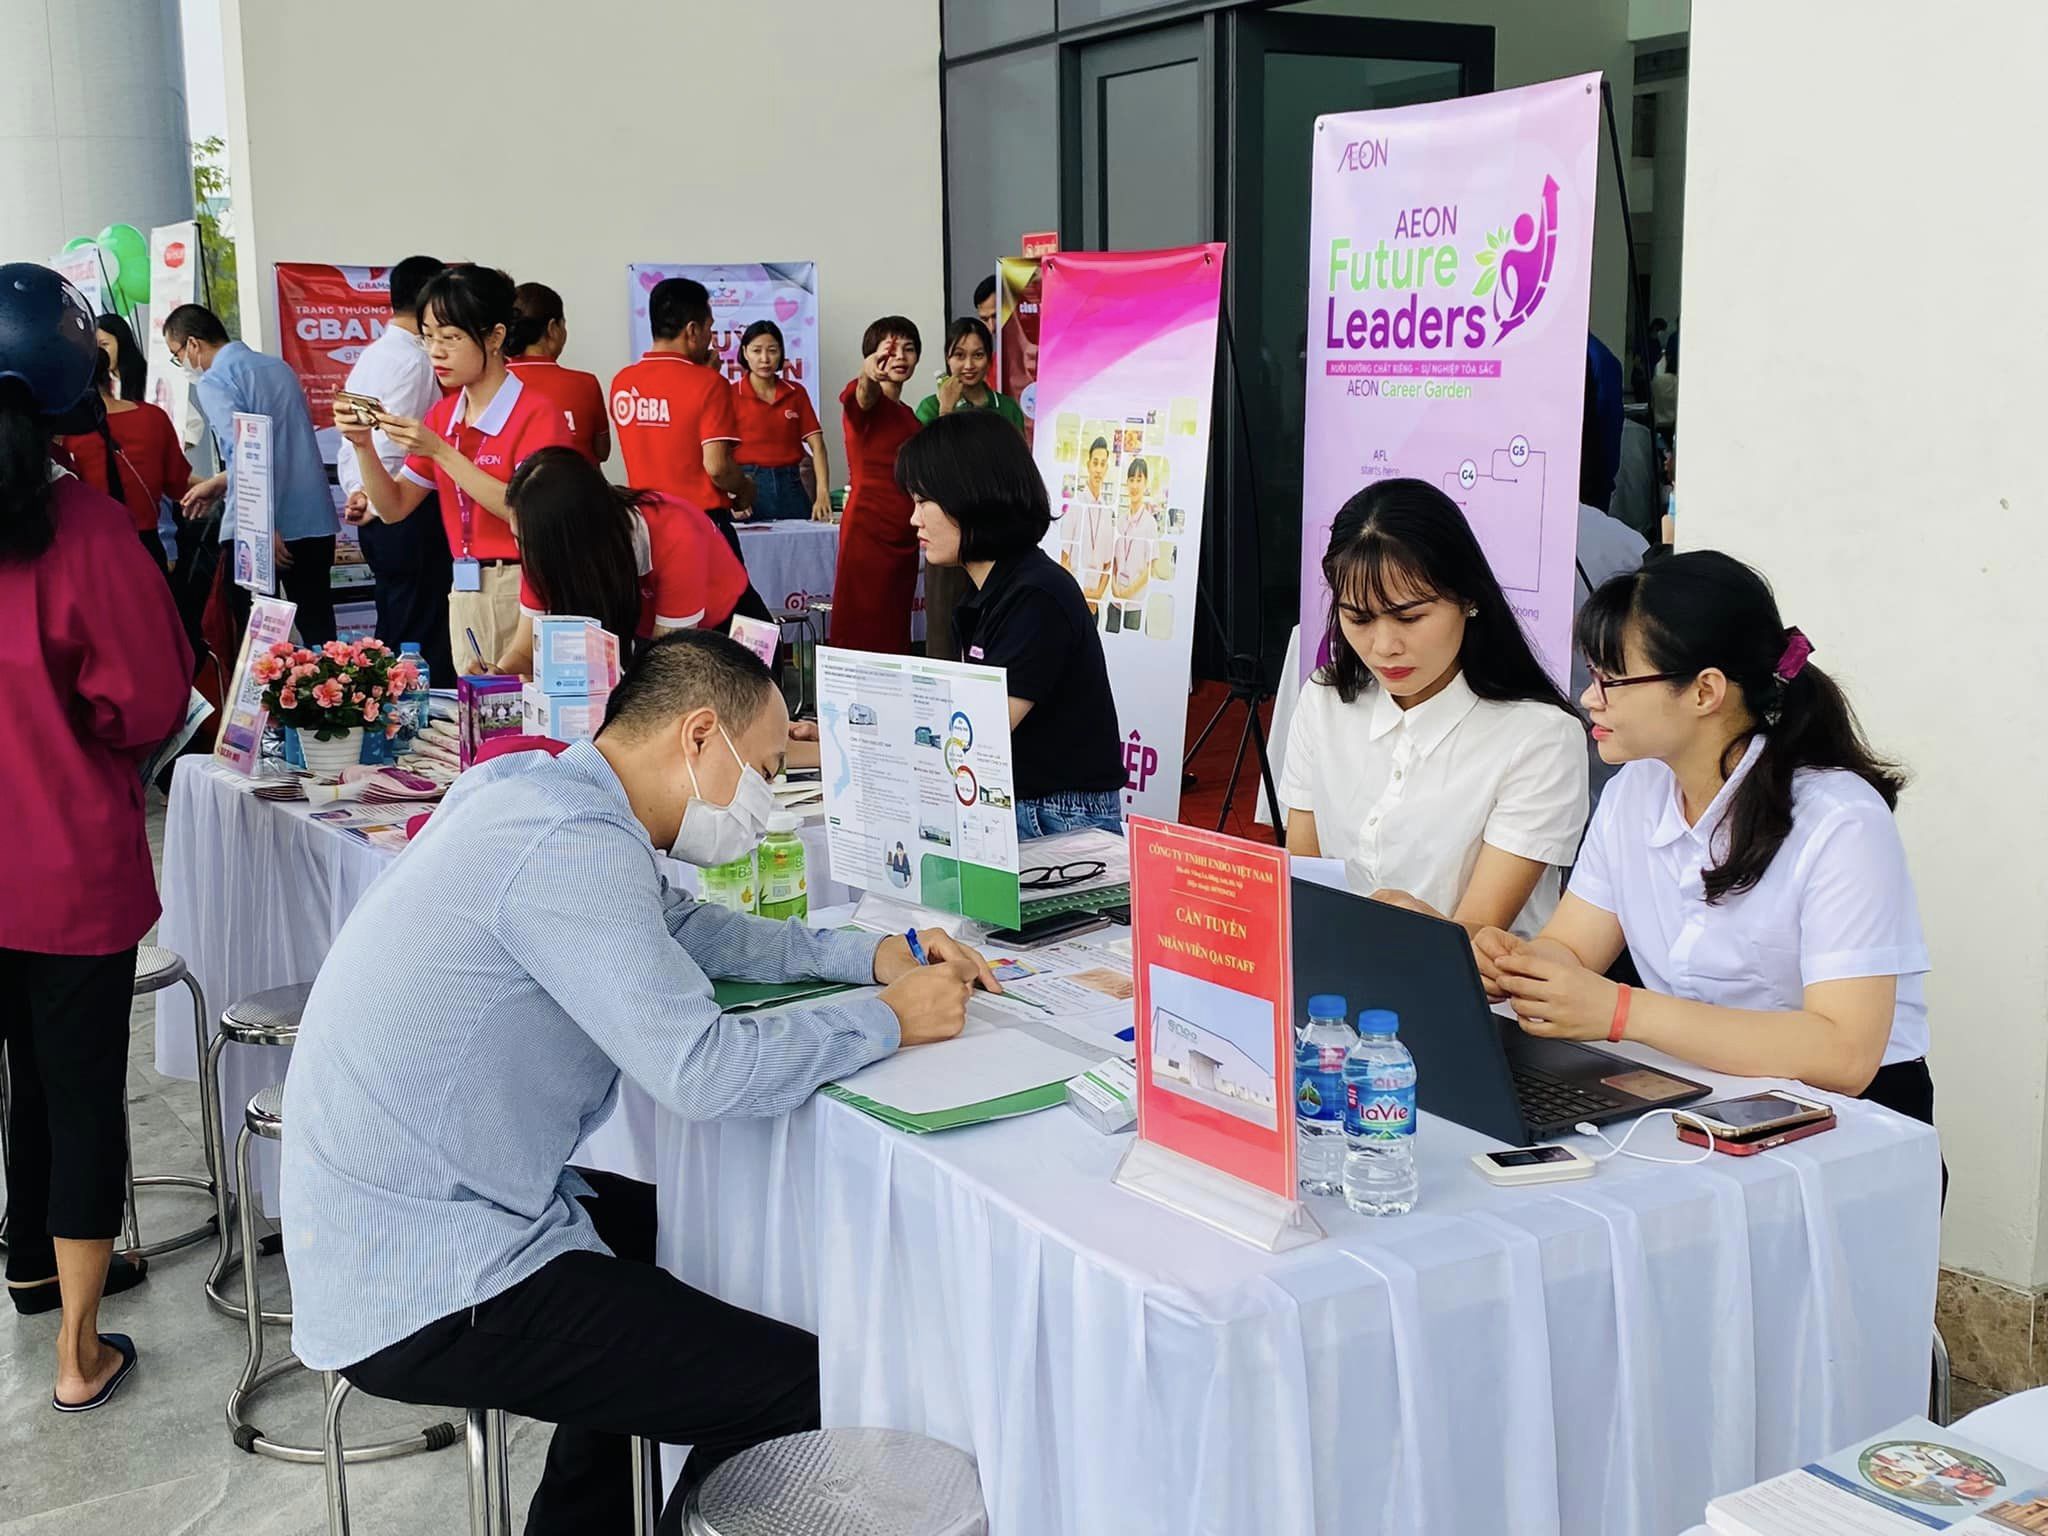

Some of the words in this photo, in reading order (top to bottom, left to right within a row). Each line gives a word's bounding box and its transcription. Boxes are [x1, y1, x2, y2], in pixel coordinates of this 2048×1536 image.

[1394, 204, 1458, 240] AEON
[1329, 238, 1459, 291] Future
[1326, 292, 1487, 350] Leaders
[1347, 379, 1379, 397] AEON
[1381, 380, 1422, 397] Career
[1424, 380, 1473, 399] Garden
[636, 397, 670, 422] GBA
[1373, 449, 1388, 462] AFL
[1512, 445, 1525, 457] G5
[1360, 465, 1382, 476] starts
[1382, 467, 1401, 476] here
[1461, 469, 1474, 481] G4
[1253, 868, 1274, 883] NAM
[1209, 950, 1225, 966] QA
[1224, 953, 1256, 974] STAFF
[1360, 1102, 1409, 1120] laVie
